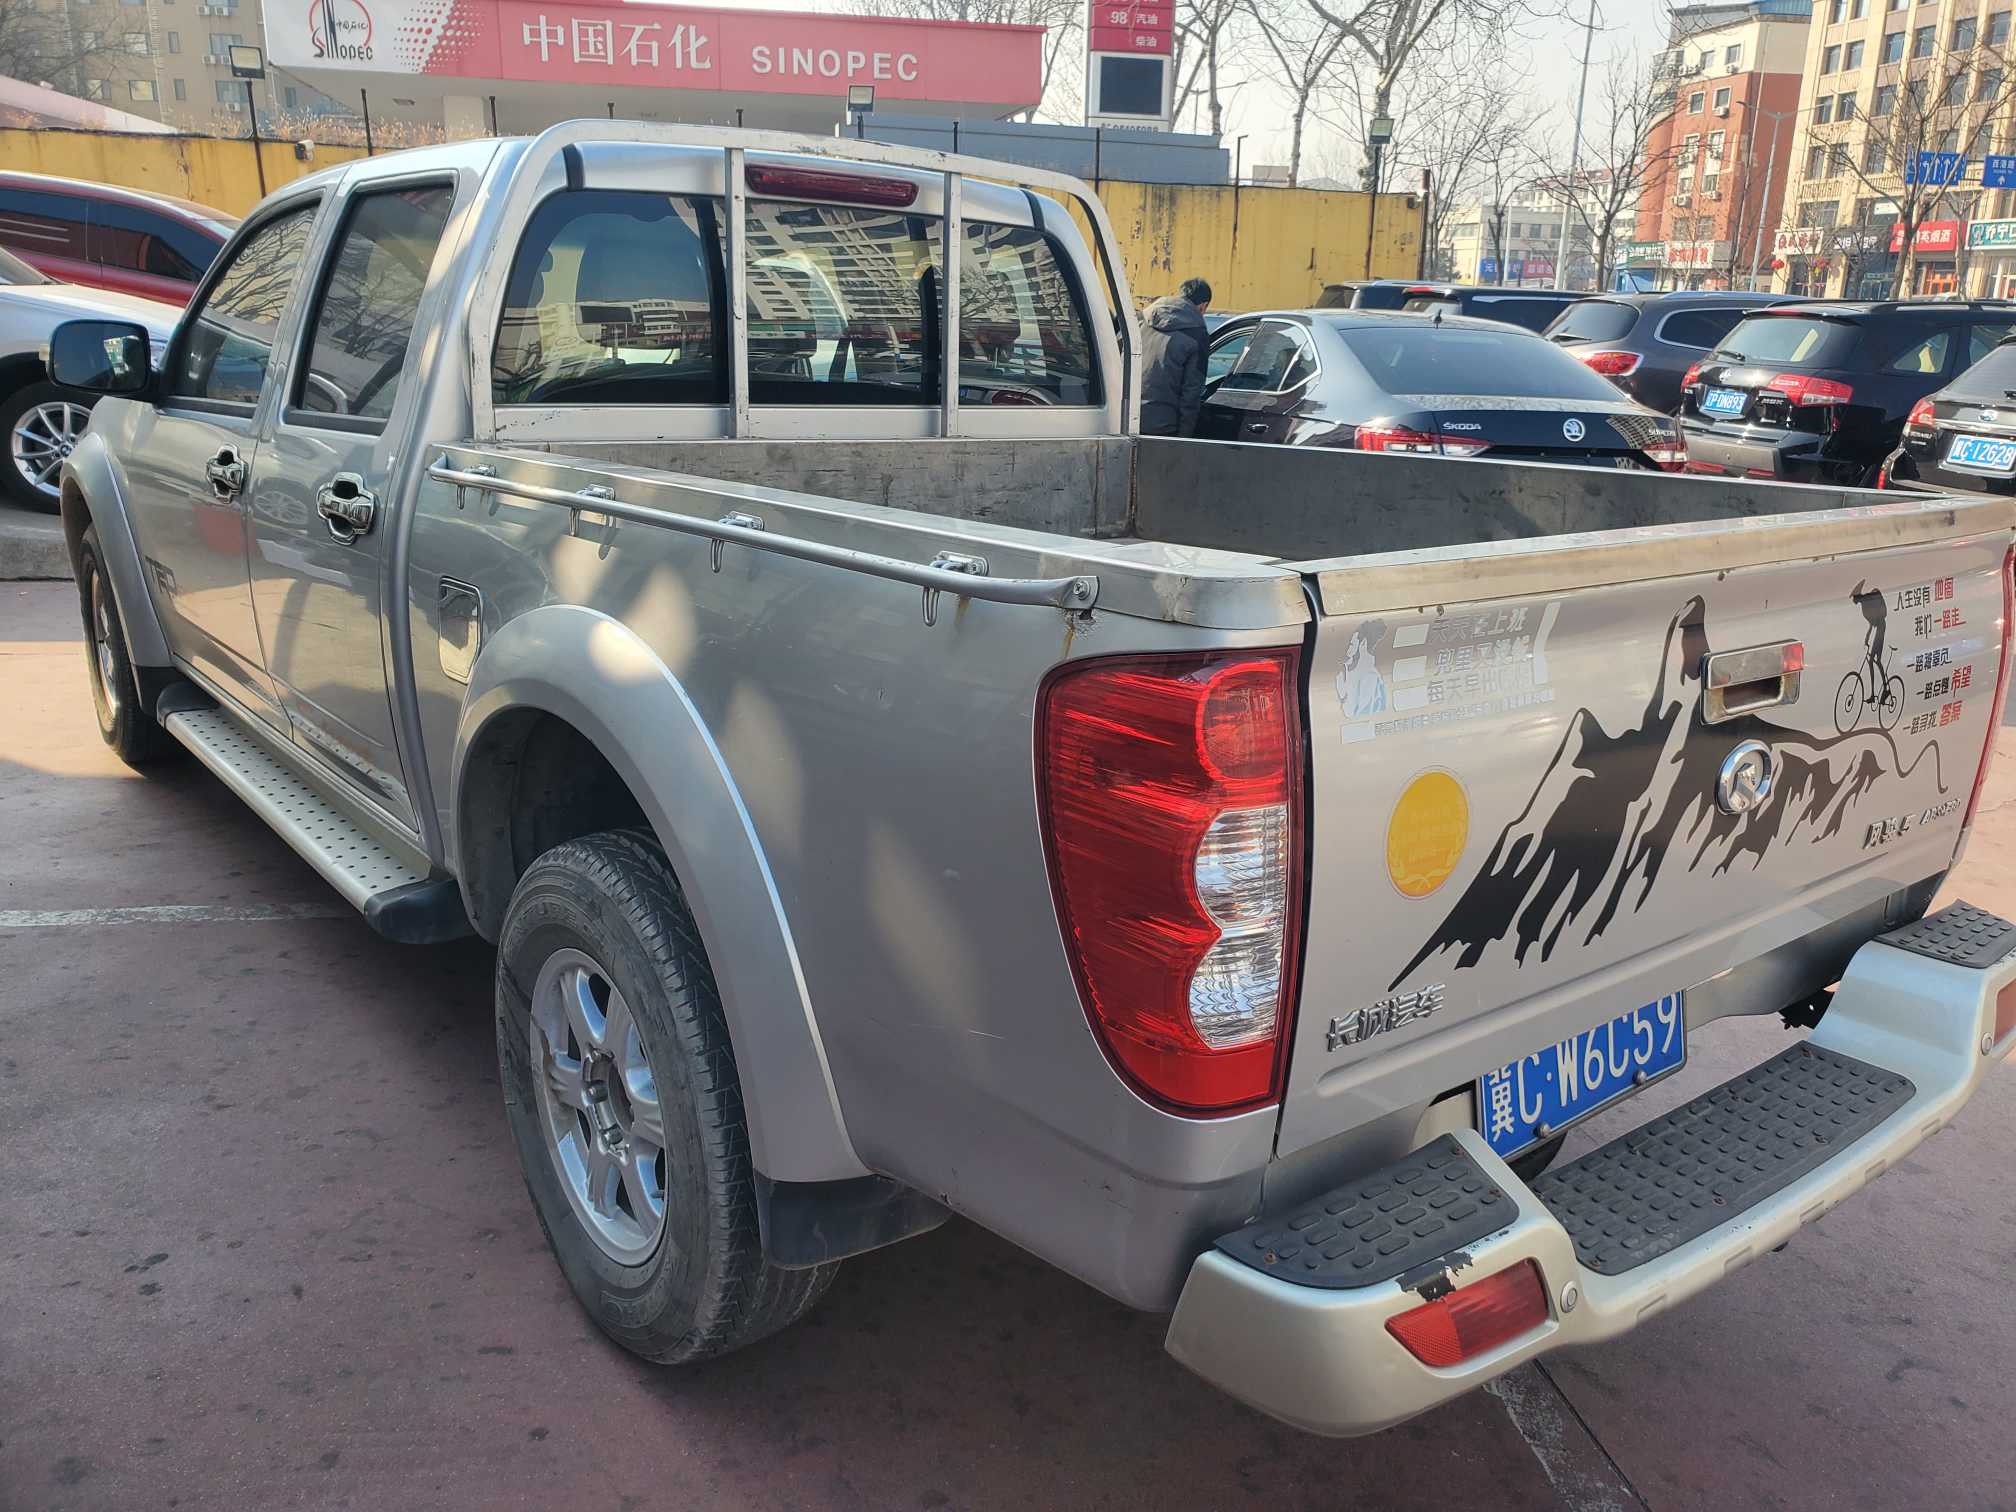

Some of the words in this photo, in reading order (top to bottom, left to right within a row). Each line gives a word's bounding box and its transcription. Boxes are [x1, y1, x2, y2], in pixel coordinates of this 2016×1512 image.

[1110, 11, 1128, 25] 98
[522, 14, 711, 70] 中国石化
[751, 45, 918, 82] SINOPEC
[1442, 421, 1482, 431] ŠKODA
